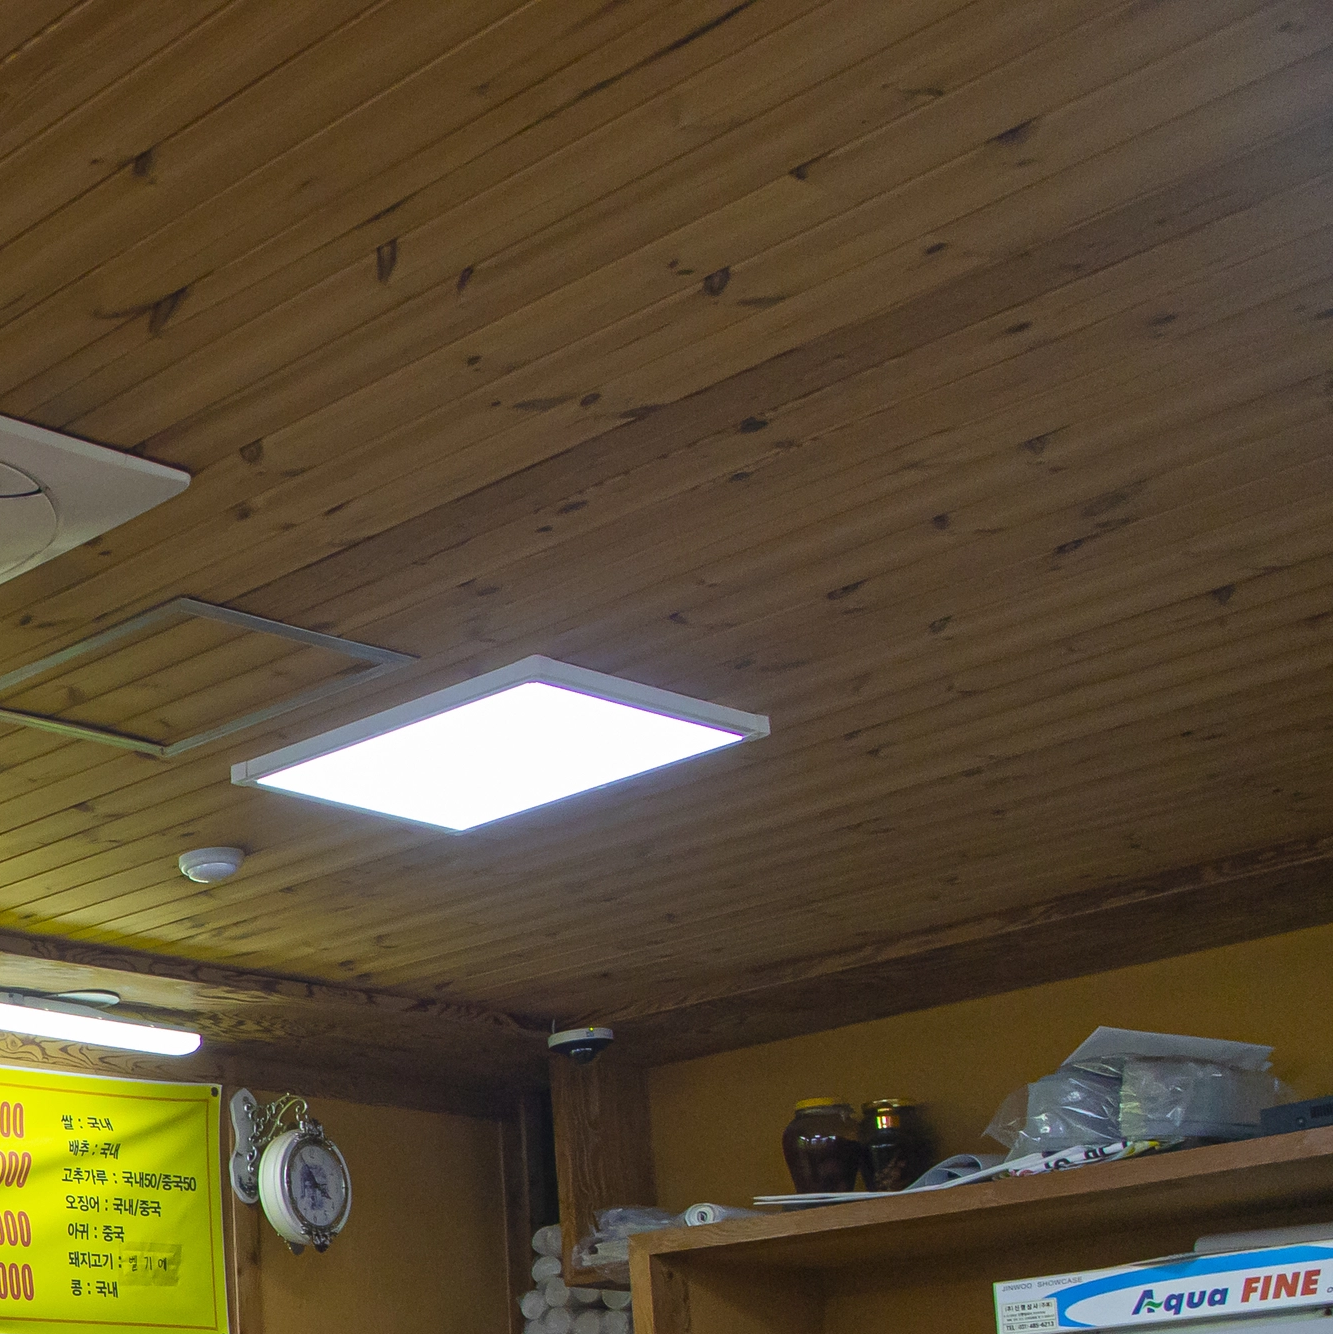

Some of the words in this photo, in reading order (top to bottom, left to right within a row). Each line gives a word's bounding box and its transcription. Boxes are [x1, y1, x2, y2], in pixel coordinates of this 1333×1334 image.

[61, 1115, 73, 1130] 쌀
[87, 1117, 113, 1132] 국내
[69, 1140, 90, 1157] 배추
[99, 1143, 121, 1159] 국내
[61, 1167, 108, 1185] 고추가루
[122, 1171, 196, 1191] 국내50/중국50
[66, 1195, 99, 1213] 오징어
[113, 1198, 161, 1217] 국내/중국
[68, 1223, 89, 1240] 아귀
[103, 1225, 124, 1243] 중국
[69, 1251, 113, 1270] 돼지고기
[71, 1279, 83, 1296] 콩
[96, 1281, 118, 1298] 국내
[1002, 1283, 1032, 1292] JINWOO
[1037, 1276, 1083, 1288] SHOWCASE
[1131, 1284, 1230, 1316] Aqua
[1240, 1268, 1322, 1304] FINE
